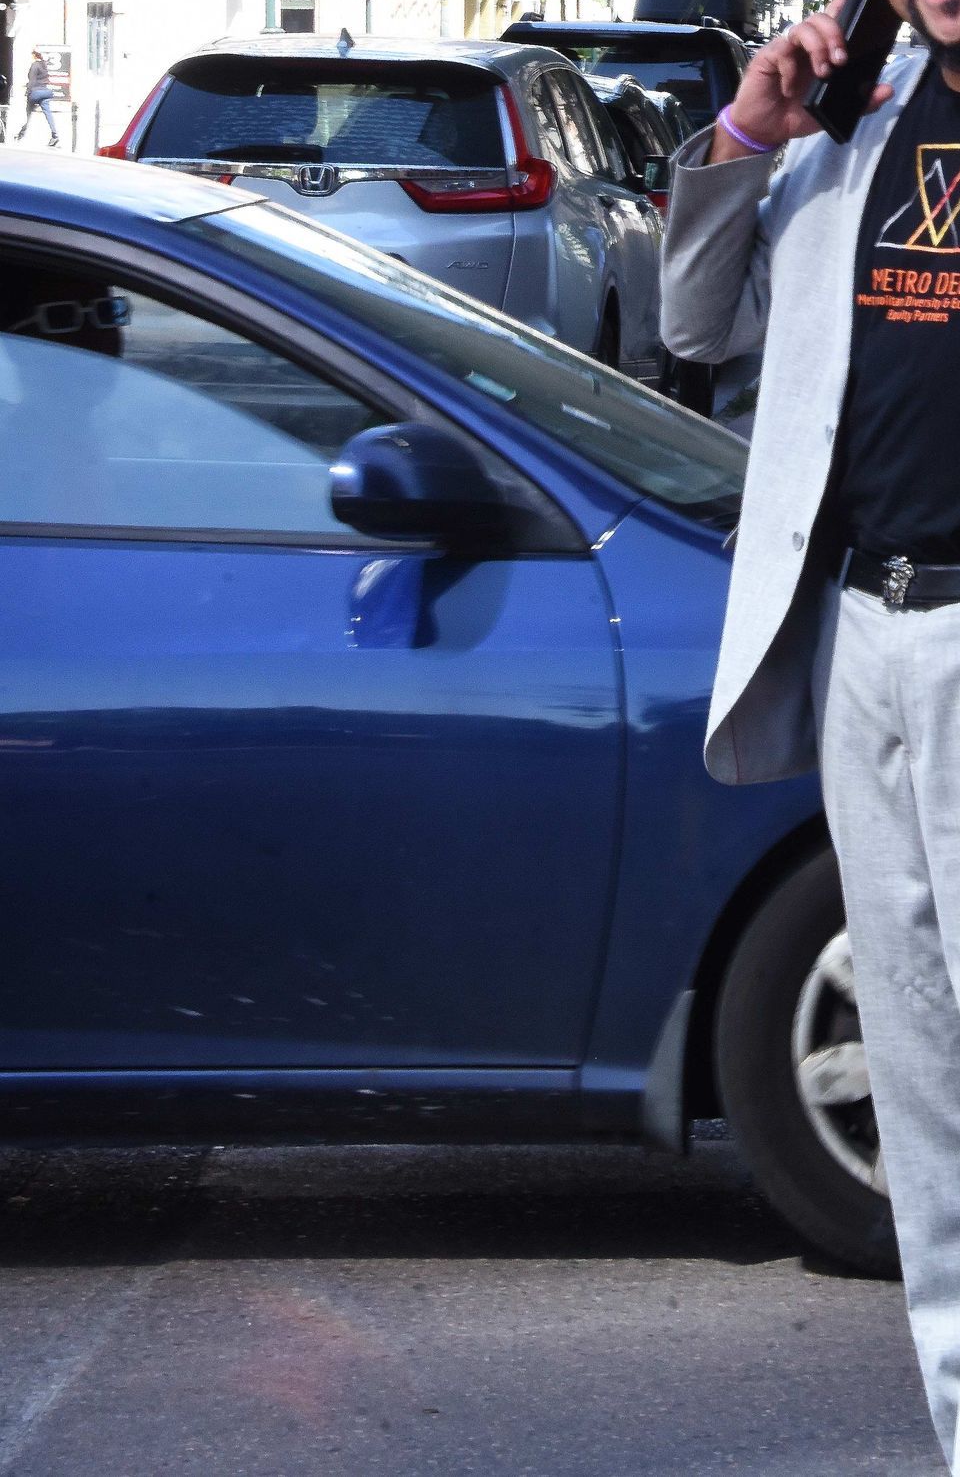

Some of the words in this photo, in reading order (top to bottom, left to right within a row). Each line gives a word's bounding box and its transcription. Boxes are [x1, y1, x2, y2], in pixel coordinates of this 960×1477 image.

[871, 268, 932, 294] METRO
[905, 295, 940, 311] Diversity
[913, 309, 949, 323] Partners
